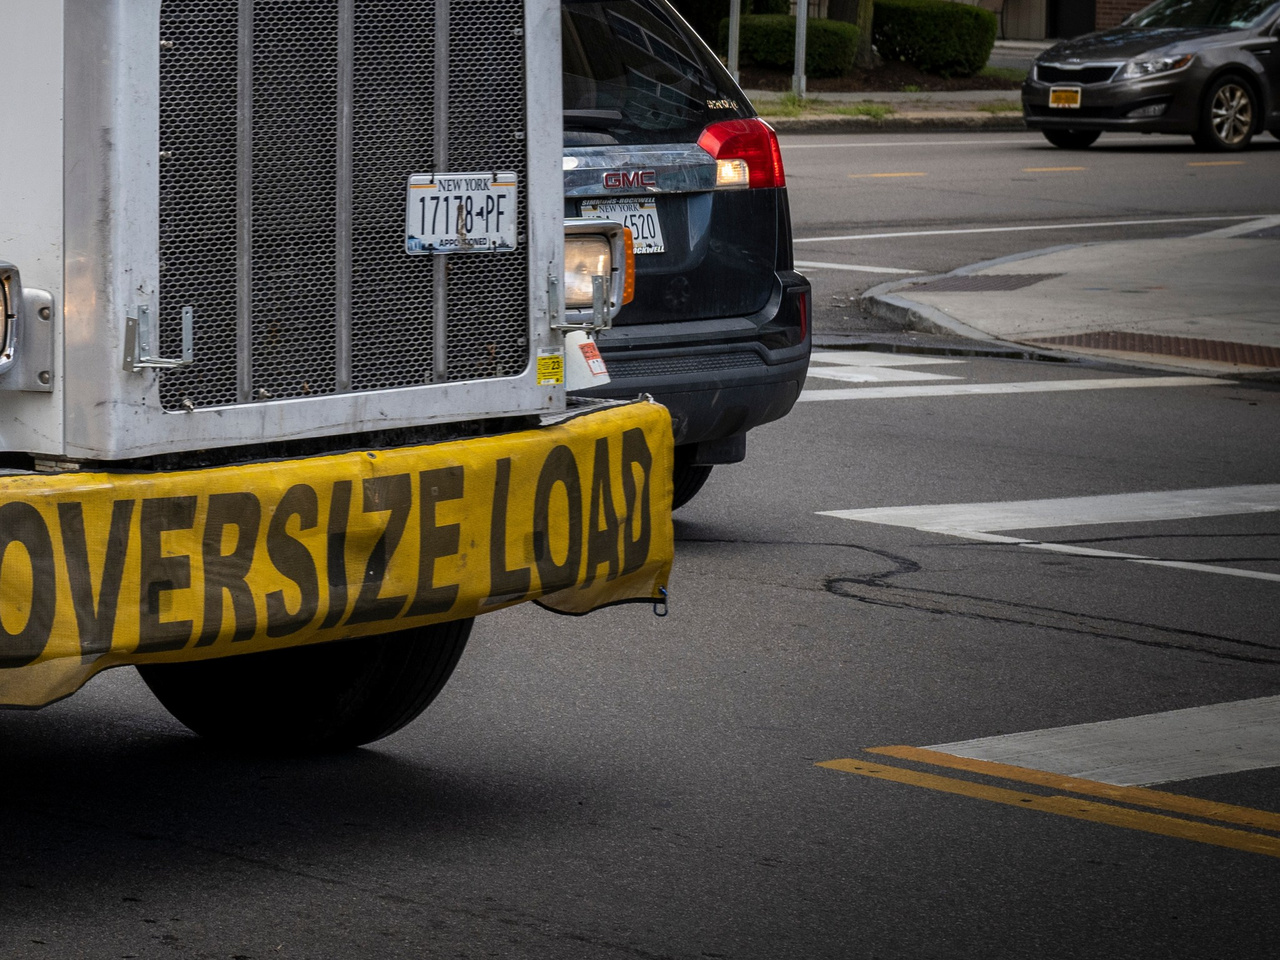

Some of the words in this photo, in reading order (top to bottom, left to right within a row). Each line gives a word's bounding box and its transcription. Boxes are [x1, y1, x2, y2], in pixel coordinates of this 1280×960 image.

[438, 179, 463, 192] NEW
[463, 178, 490, 192] YORK
[602, 170, 656, 189] GMC
[599, 204, 617, 213] NEW
[618, 203, 640, 212] YORK
[486, 426, 654, 600] LOAD
